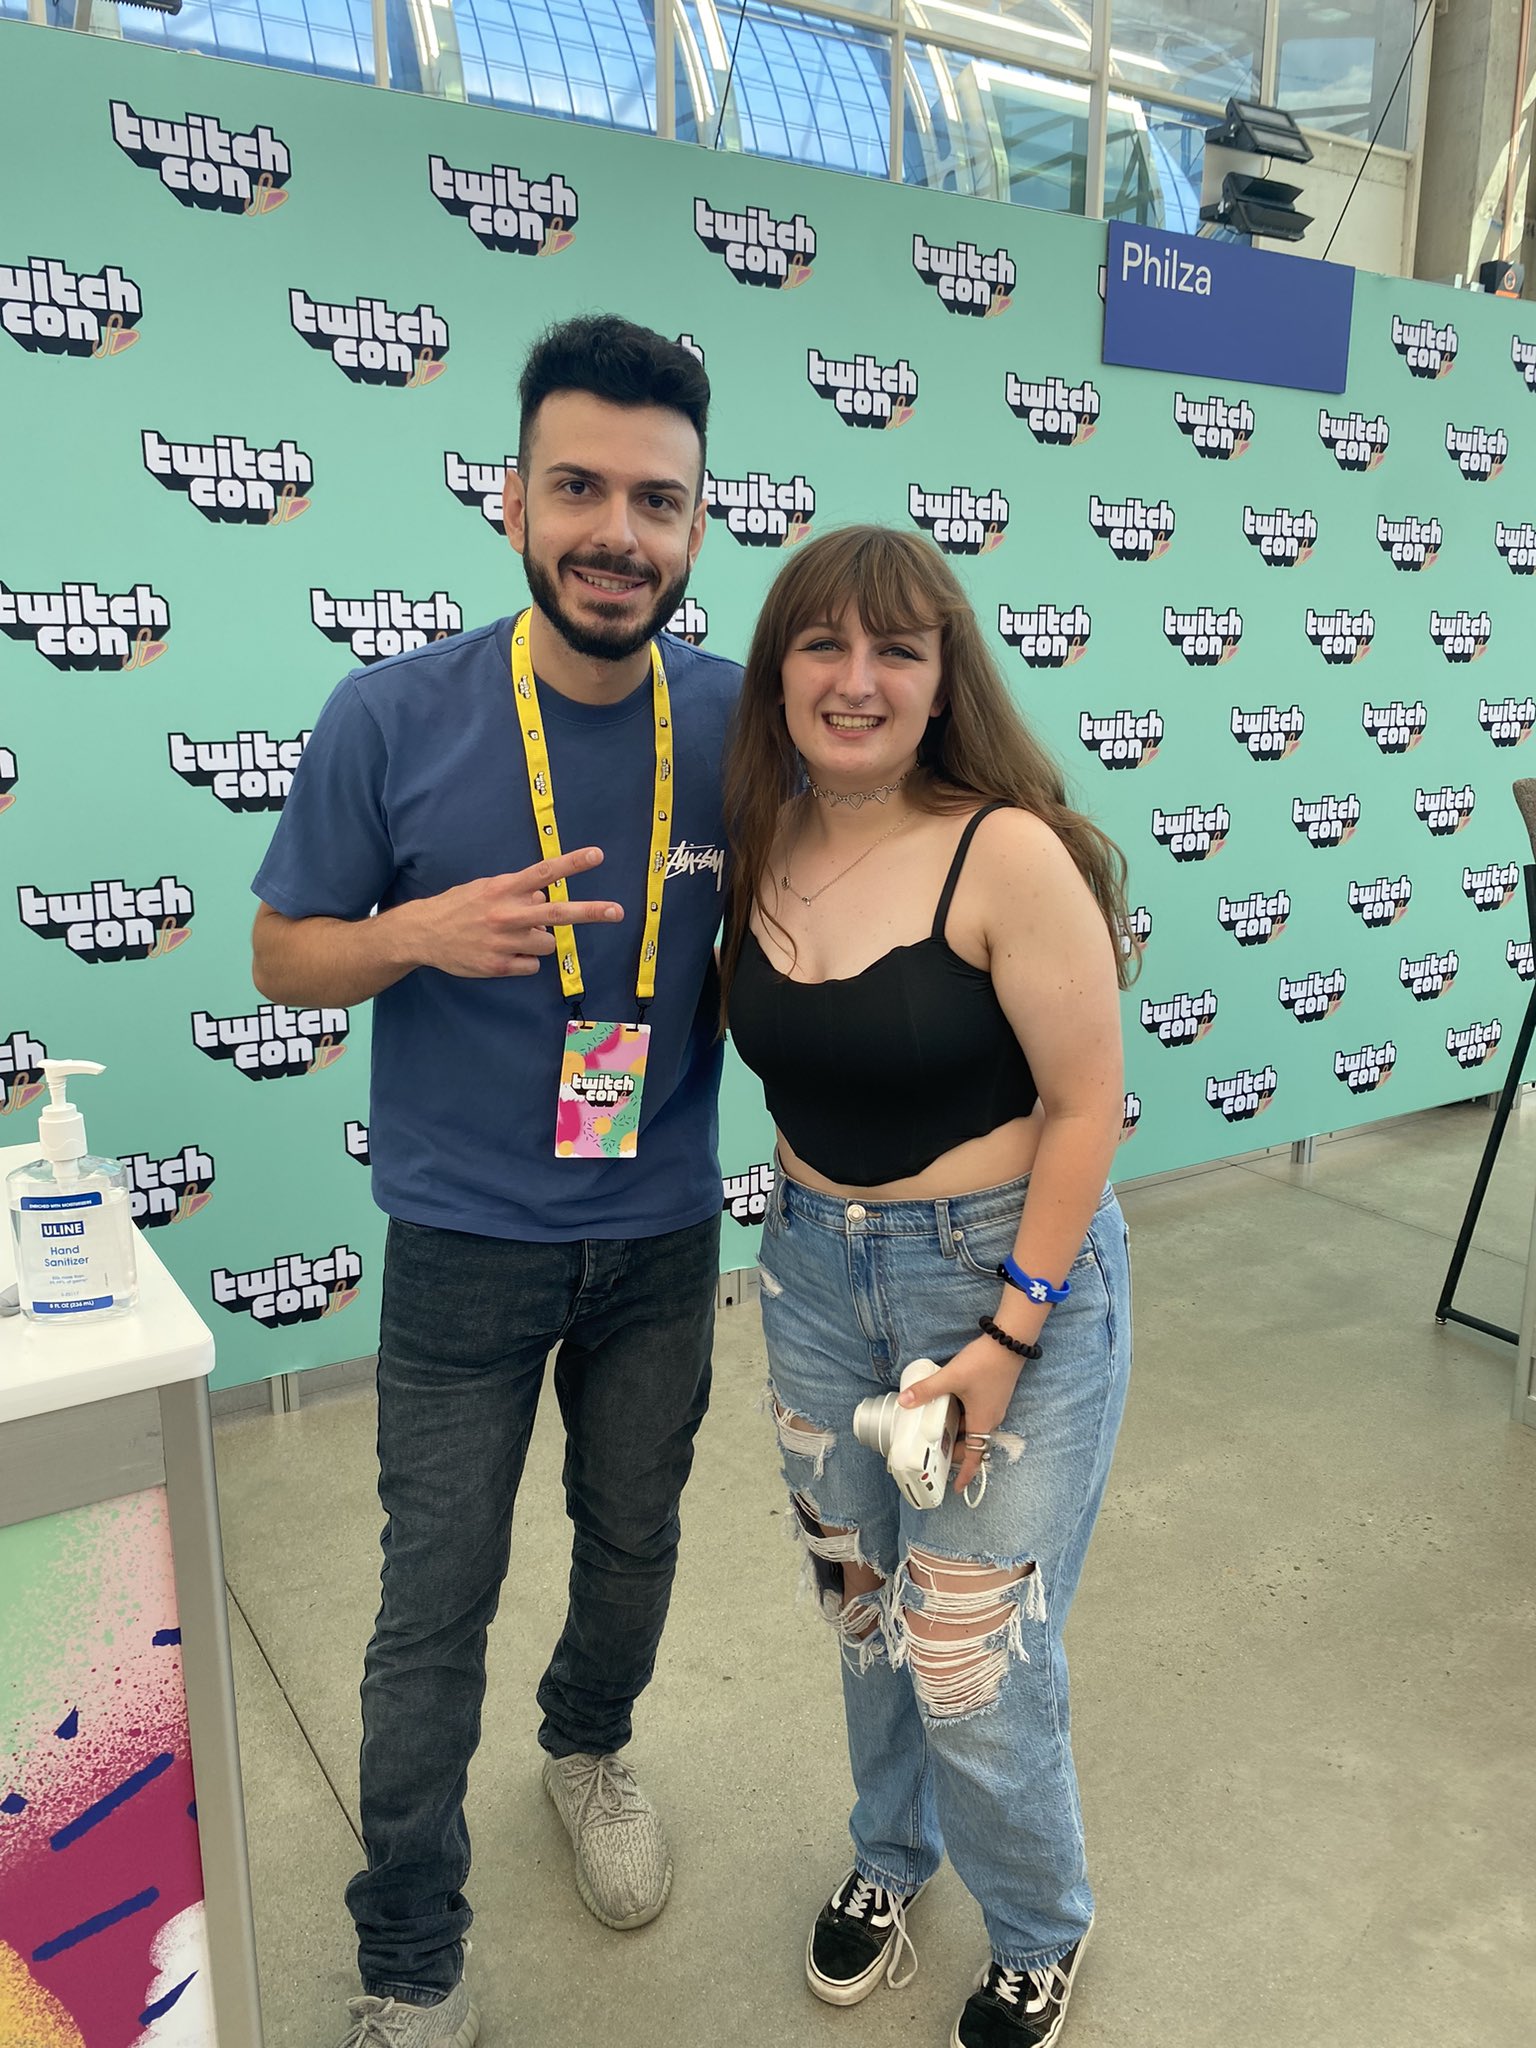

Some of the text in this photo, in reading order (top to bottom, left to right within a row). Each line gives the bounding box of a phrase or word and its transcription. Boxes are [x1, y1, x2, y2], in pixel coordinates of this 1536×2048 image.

[111, 101, 290, 175] twitch
[160, 155, 252, 201] con
[429, 156, 577, 218] twitch
[468, 203, 545, 243] con
[694, 199, 816, 255] twitch
[725, 241, 788, 277] con
[913, 235, 1015, 286] twitch
[1122, 240, 1212, 296] Philza
[0, 257, 141, 315] witch
[937, 274, 992, 307] con
[0, 300, 101, 345] con
[290, 289, 449, 348] twitch
[1392, 317, 1456, 353] twitch
[332, 336, 414, 375] con
[1407, 346, 1441, 370] con
[808, 349, 917, 396] twitch
[834, 387, 898, 419] con
[1006, 373, 1099, 414] twitch
[1029, 408, 1077, 436] con
[1175, 392, 1253, 431] twitch
[1320, 409, 1388, 444] twitch
[1193, 425, 1235, 452] con
[1335, 439, 1371, 463] con
[1447, 424, 1506, 455] twitch
[142, 431, 312, 484] twitch
[1459, 451, 1492, 473] con
[188, 476, 277, 512] con
[909, 484, 1009, 523] twitch
[726, 506, 788, 536] con
[1091, 494, 1173, 530] twitch
[1244, 506, 1316, 538] twitch
[932, 517, 990, 545] con
[1110, 527, 1154, 551] con
[1378, 515, 1441, 545] twitch
[1496, 521, 1536, 549] twit
[1260, 536, 1299, 557] con
[1391, 542, 1426, 563] con
[310, 589, 461, 631] twitch
[999, 603, 1089, 635] twitch
[1165, 606, 1241, 636] twitch
[1307, 609, 1374, 636] twitch
[1431, 610, 1489, 636] twitch
[36, 624, 131, 657] con
[1021, 635, 1068, 658] con
[1182, 635, 1223, 656] con
[1321, 636, 1357, 655] con
[1443, 636, 1476, 654] con
[1081, 709, 1162, 741] twitch
[1231, 704, 1303, 734] twitch
[1364, 701, 1425, 728] twitch
[1479, 698, 1535, 723] twitch
[1248, 732, 1286, 752] con
[1377, 726, 1411, 746] con
[1491, 721, 1521, 739] con
[169, 731, 312, 773] twitc
[1099, 738, 1143, 760] con
[212, 768, 294, 800] con
[1415, 784, 1474, 813] twitch
[1153, 804, 1229, 836] twitch
[1293, 793, 1358, 823] twitch
[1428, 809, 1460, 828] con
[1170, 831, 1211, 853] con
[1308, 819, 1343, 840] con
[1349, 877, 1410, 905] twitch
[1463, 862, 1518, 890] twitch
[18, 877, 193, 927] twitch
[1219, 890, 1288, 923] twitch
[1362, 900, 1396, 920] con
[1474, 885, 1504, 905] con
[66, 916, 156, 952] con
[1235, 916, 1272, 938] con
[1400, 951, 1457, 981] twitch
[1280, 970, 1344, 1001] twitch
[1412, 974, 1443, 994] con
[1142, 989, 1216, 1025] twitch
[1294, 994, 1329, 1016] con
[1158, 1017, 1198, 1040] con
[1447, 1020, 1500, 1050] twitch
[233, 1036, 314, 1071] con
[1335, 1041, 1395, 1074] twitch
[1458, 1042, 1487, 1062] con
[572, 1073, 635, 1091] twitch
[1207, 1067, 1276, 1101] twitch
[1348, 1066, 1380, 1088] con
[585, 1089, 619, 1102] con
[1222, 1093, 1259, 1115] con
[722, 1164, 775, 1199] wit
[128, 1186, 177, 1217] on
[731, 1193, 766, 1218] co
[43, 1222, 83, 1236] ULINE
[44, 1256, 89, 1267] Sanitizer
[50, 1245, 80, 1256] Hand
[212, 1246, 361, 1304] twitch
[251, 1283, 329, 1320] con
